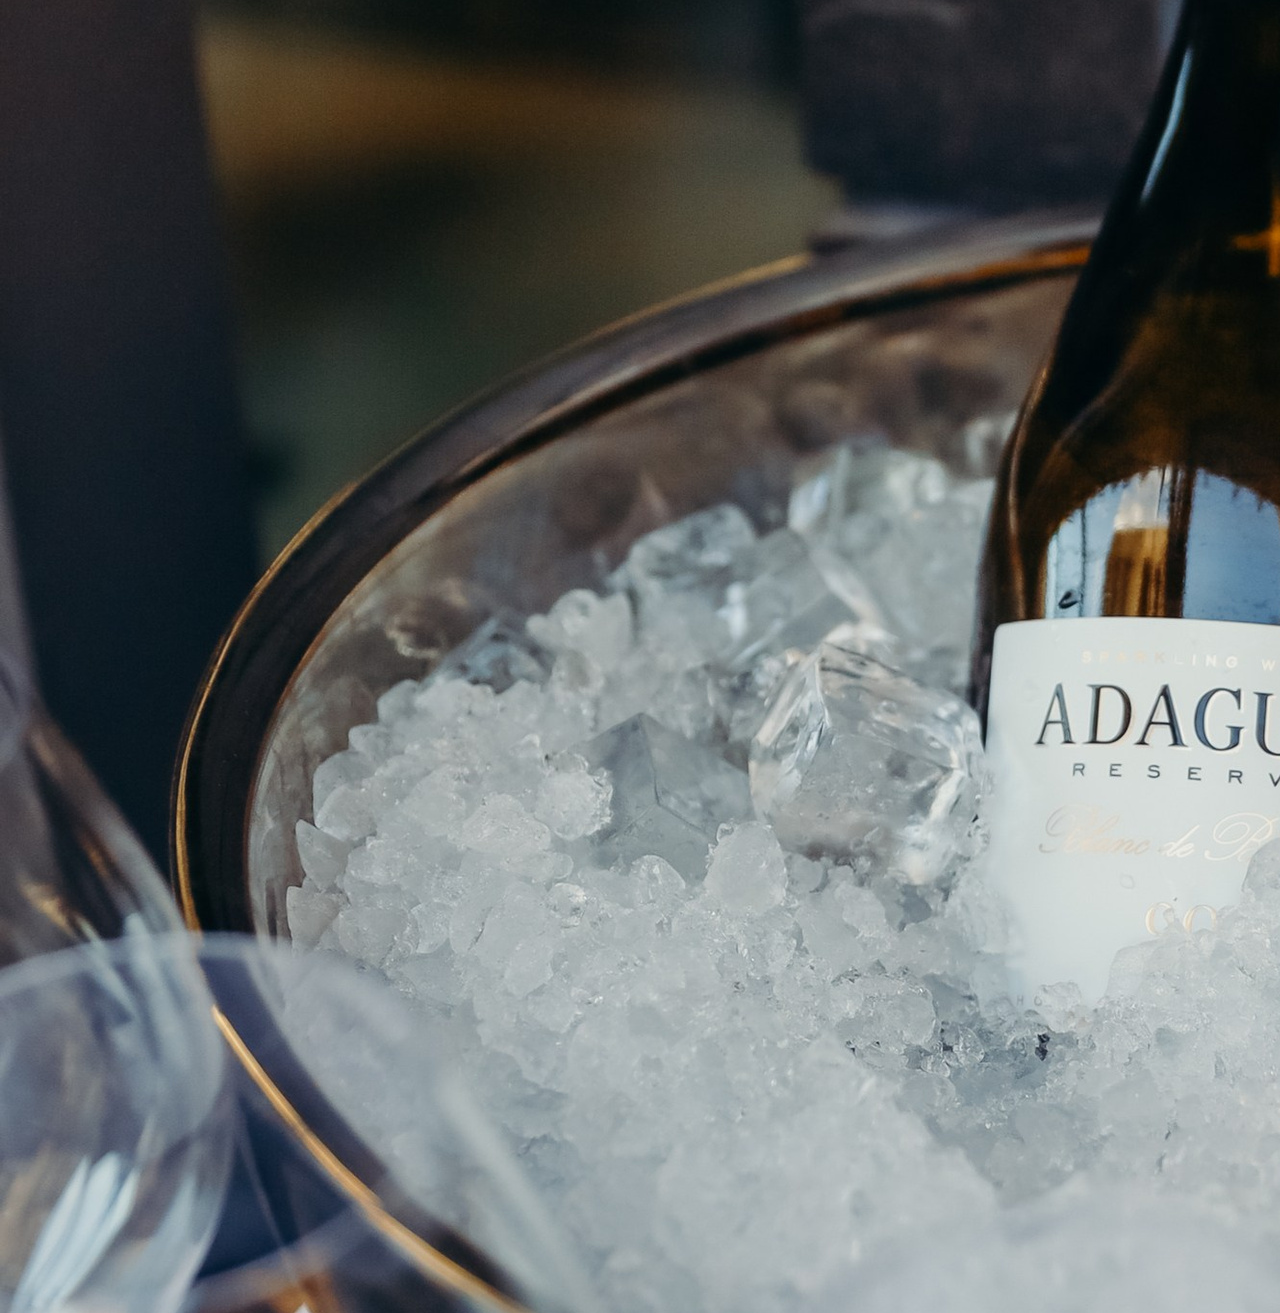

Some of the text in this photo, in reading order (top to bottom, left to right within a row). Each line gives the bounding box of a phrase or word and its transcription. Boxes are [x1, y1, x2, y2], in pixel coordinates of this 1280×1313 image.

[1081, 650, 1239, 668] SPARKLING
[1038, 803, 1151, 856] Blanc
[1158, 825, 1201, 858] de
